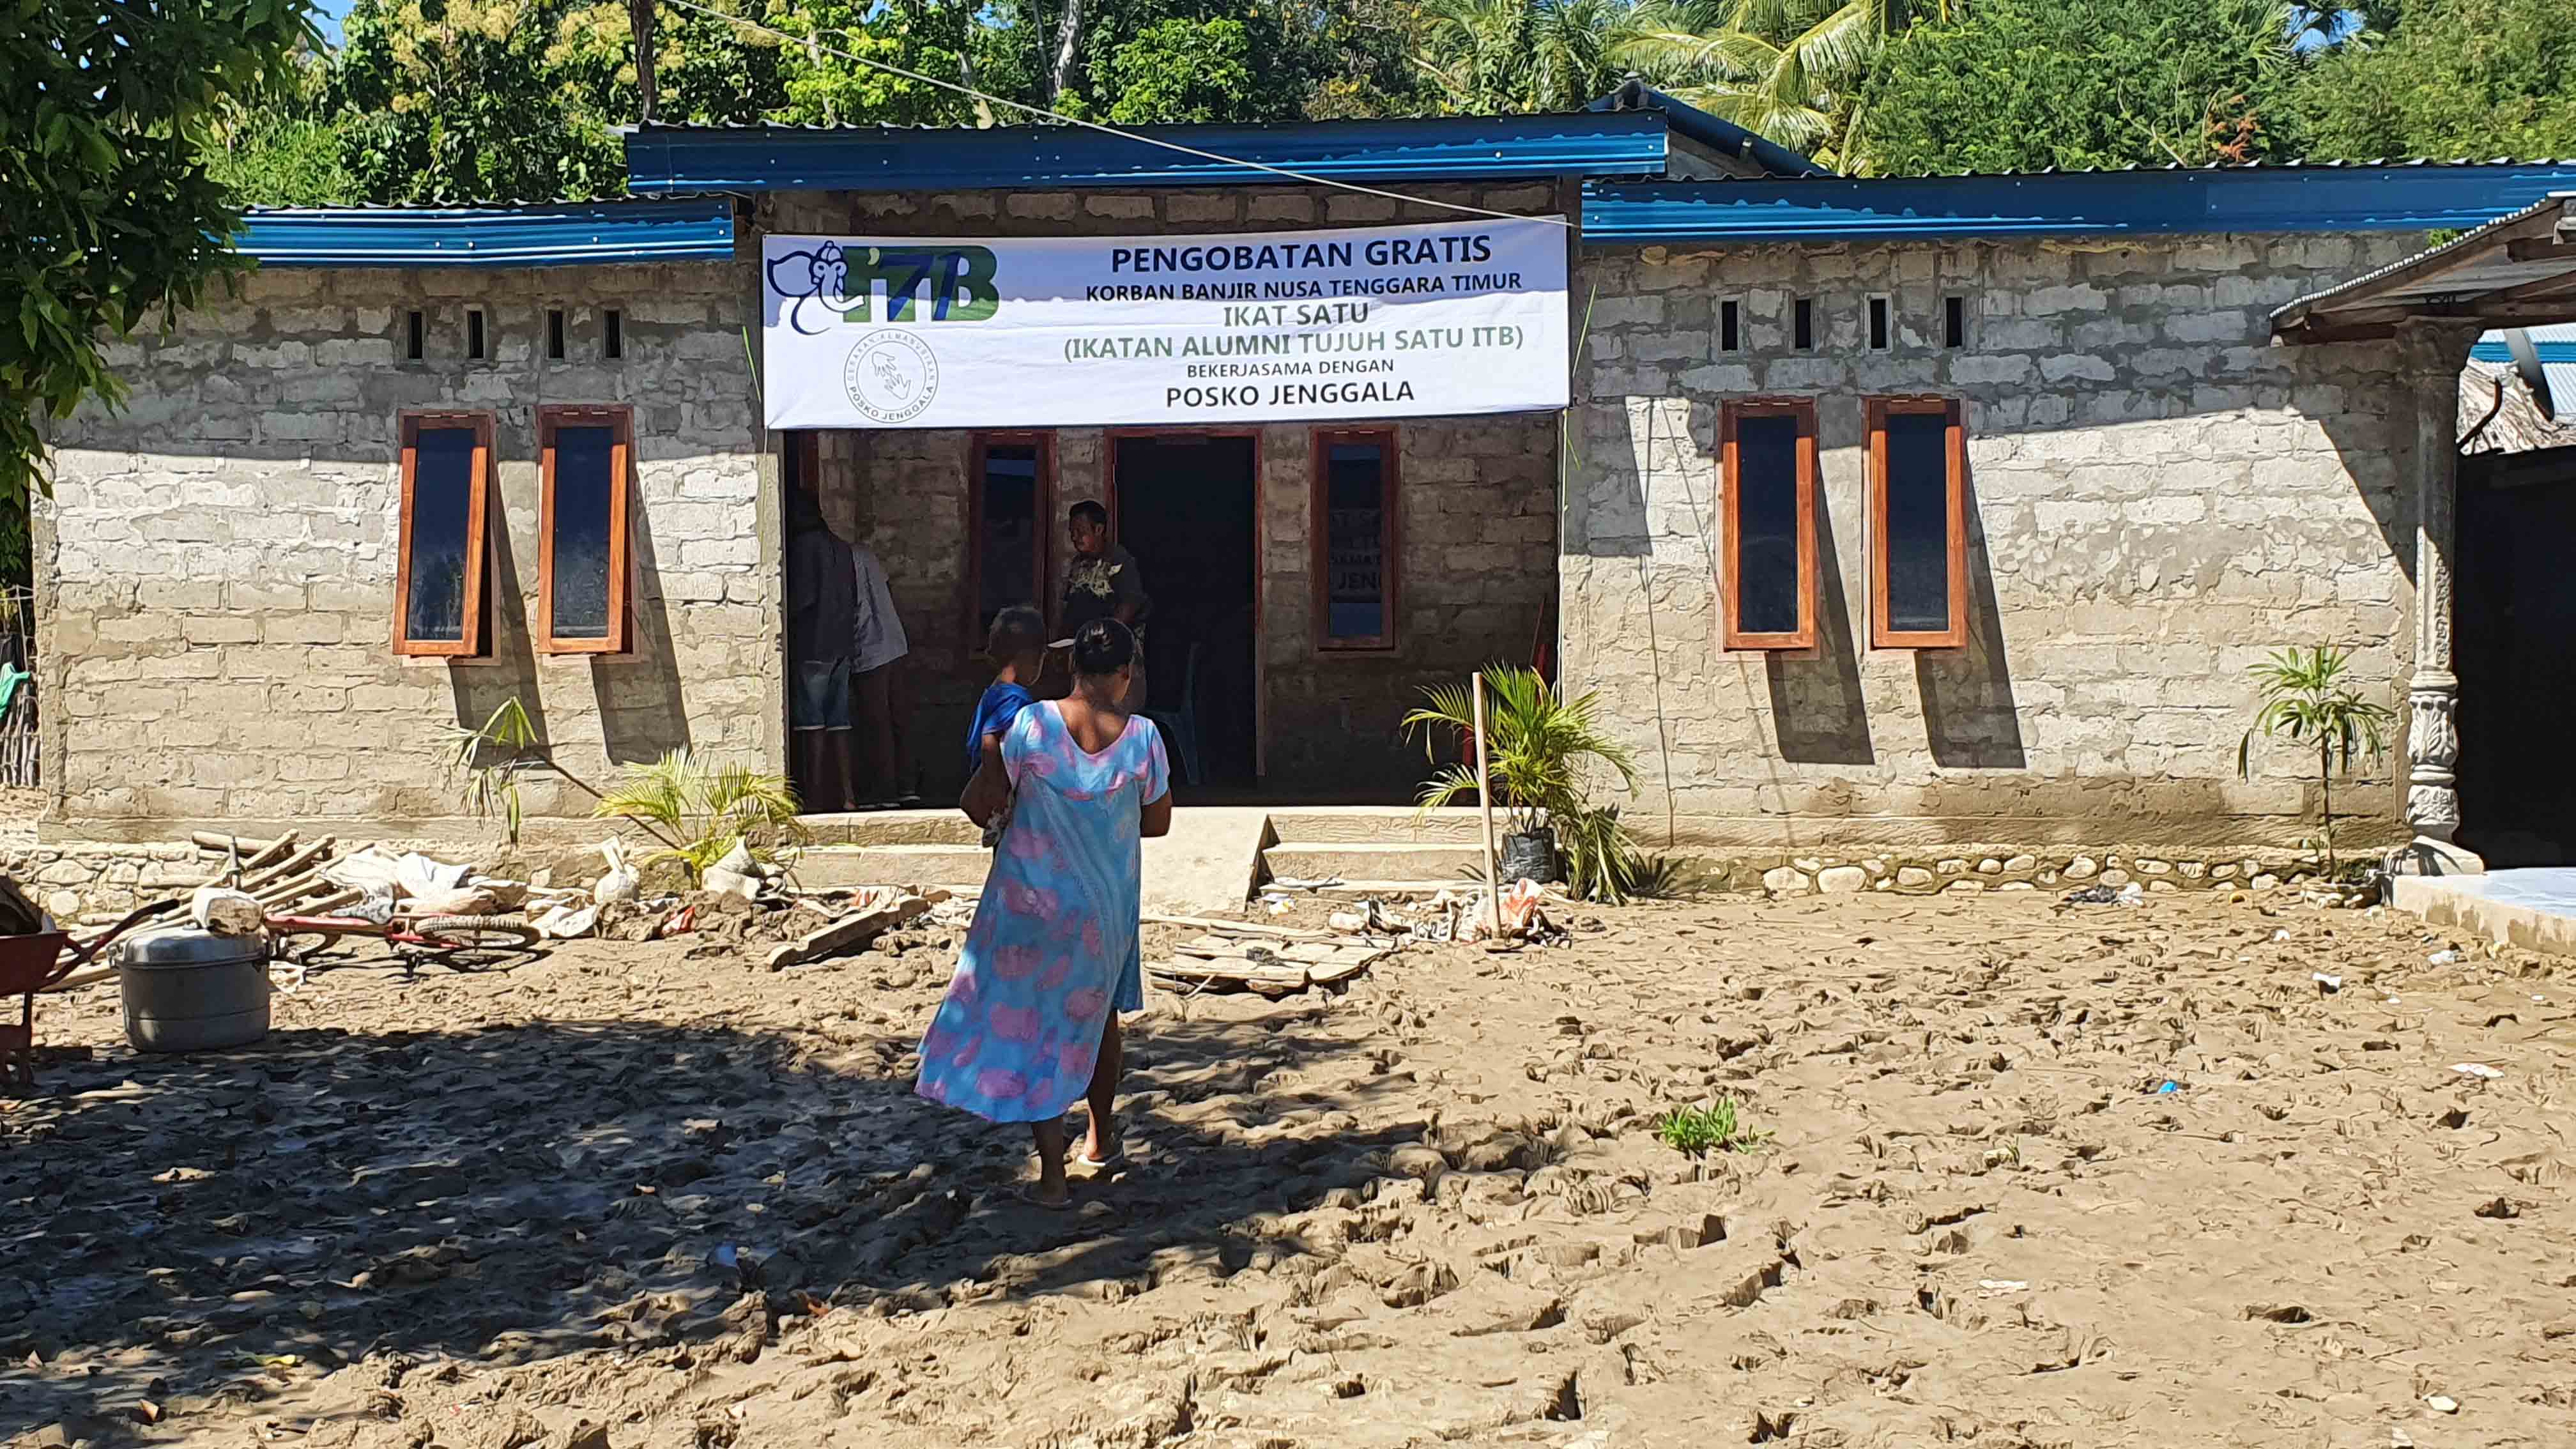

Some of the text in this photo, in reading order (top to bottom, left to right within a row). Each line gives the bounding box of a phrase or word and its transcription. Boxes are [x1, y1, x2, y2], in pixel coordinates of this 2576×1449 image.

[1112, 234, 1491, 273] PENGOBATAN GRATIS
[1085, 272, 1523, 302] KORBAN BANJIR NUSA TENGGARA TIMUR
[1223, 302, 1369, 328] IKAT SATU
[1064, 325, 1524, 364] (IKATAN ALUMNI TUJUH SATU ITB)
[1187, 358, 1395, 378] BEKERJASAMA DENGAN
[850, 385, 935, 421] POSKO JENGGALA
[1167, 381, 1416, 408] POSKO JENGGALA
